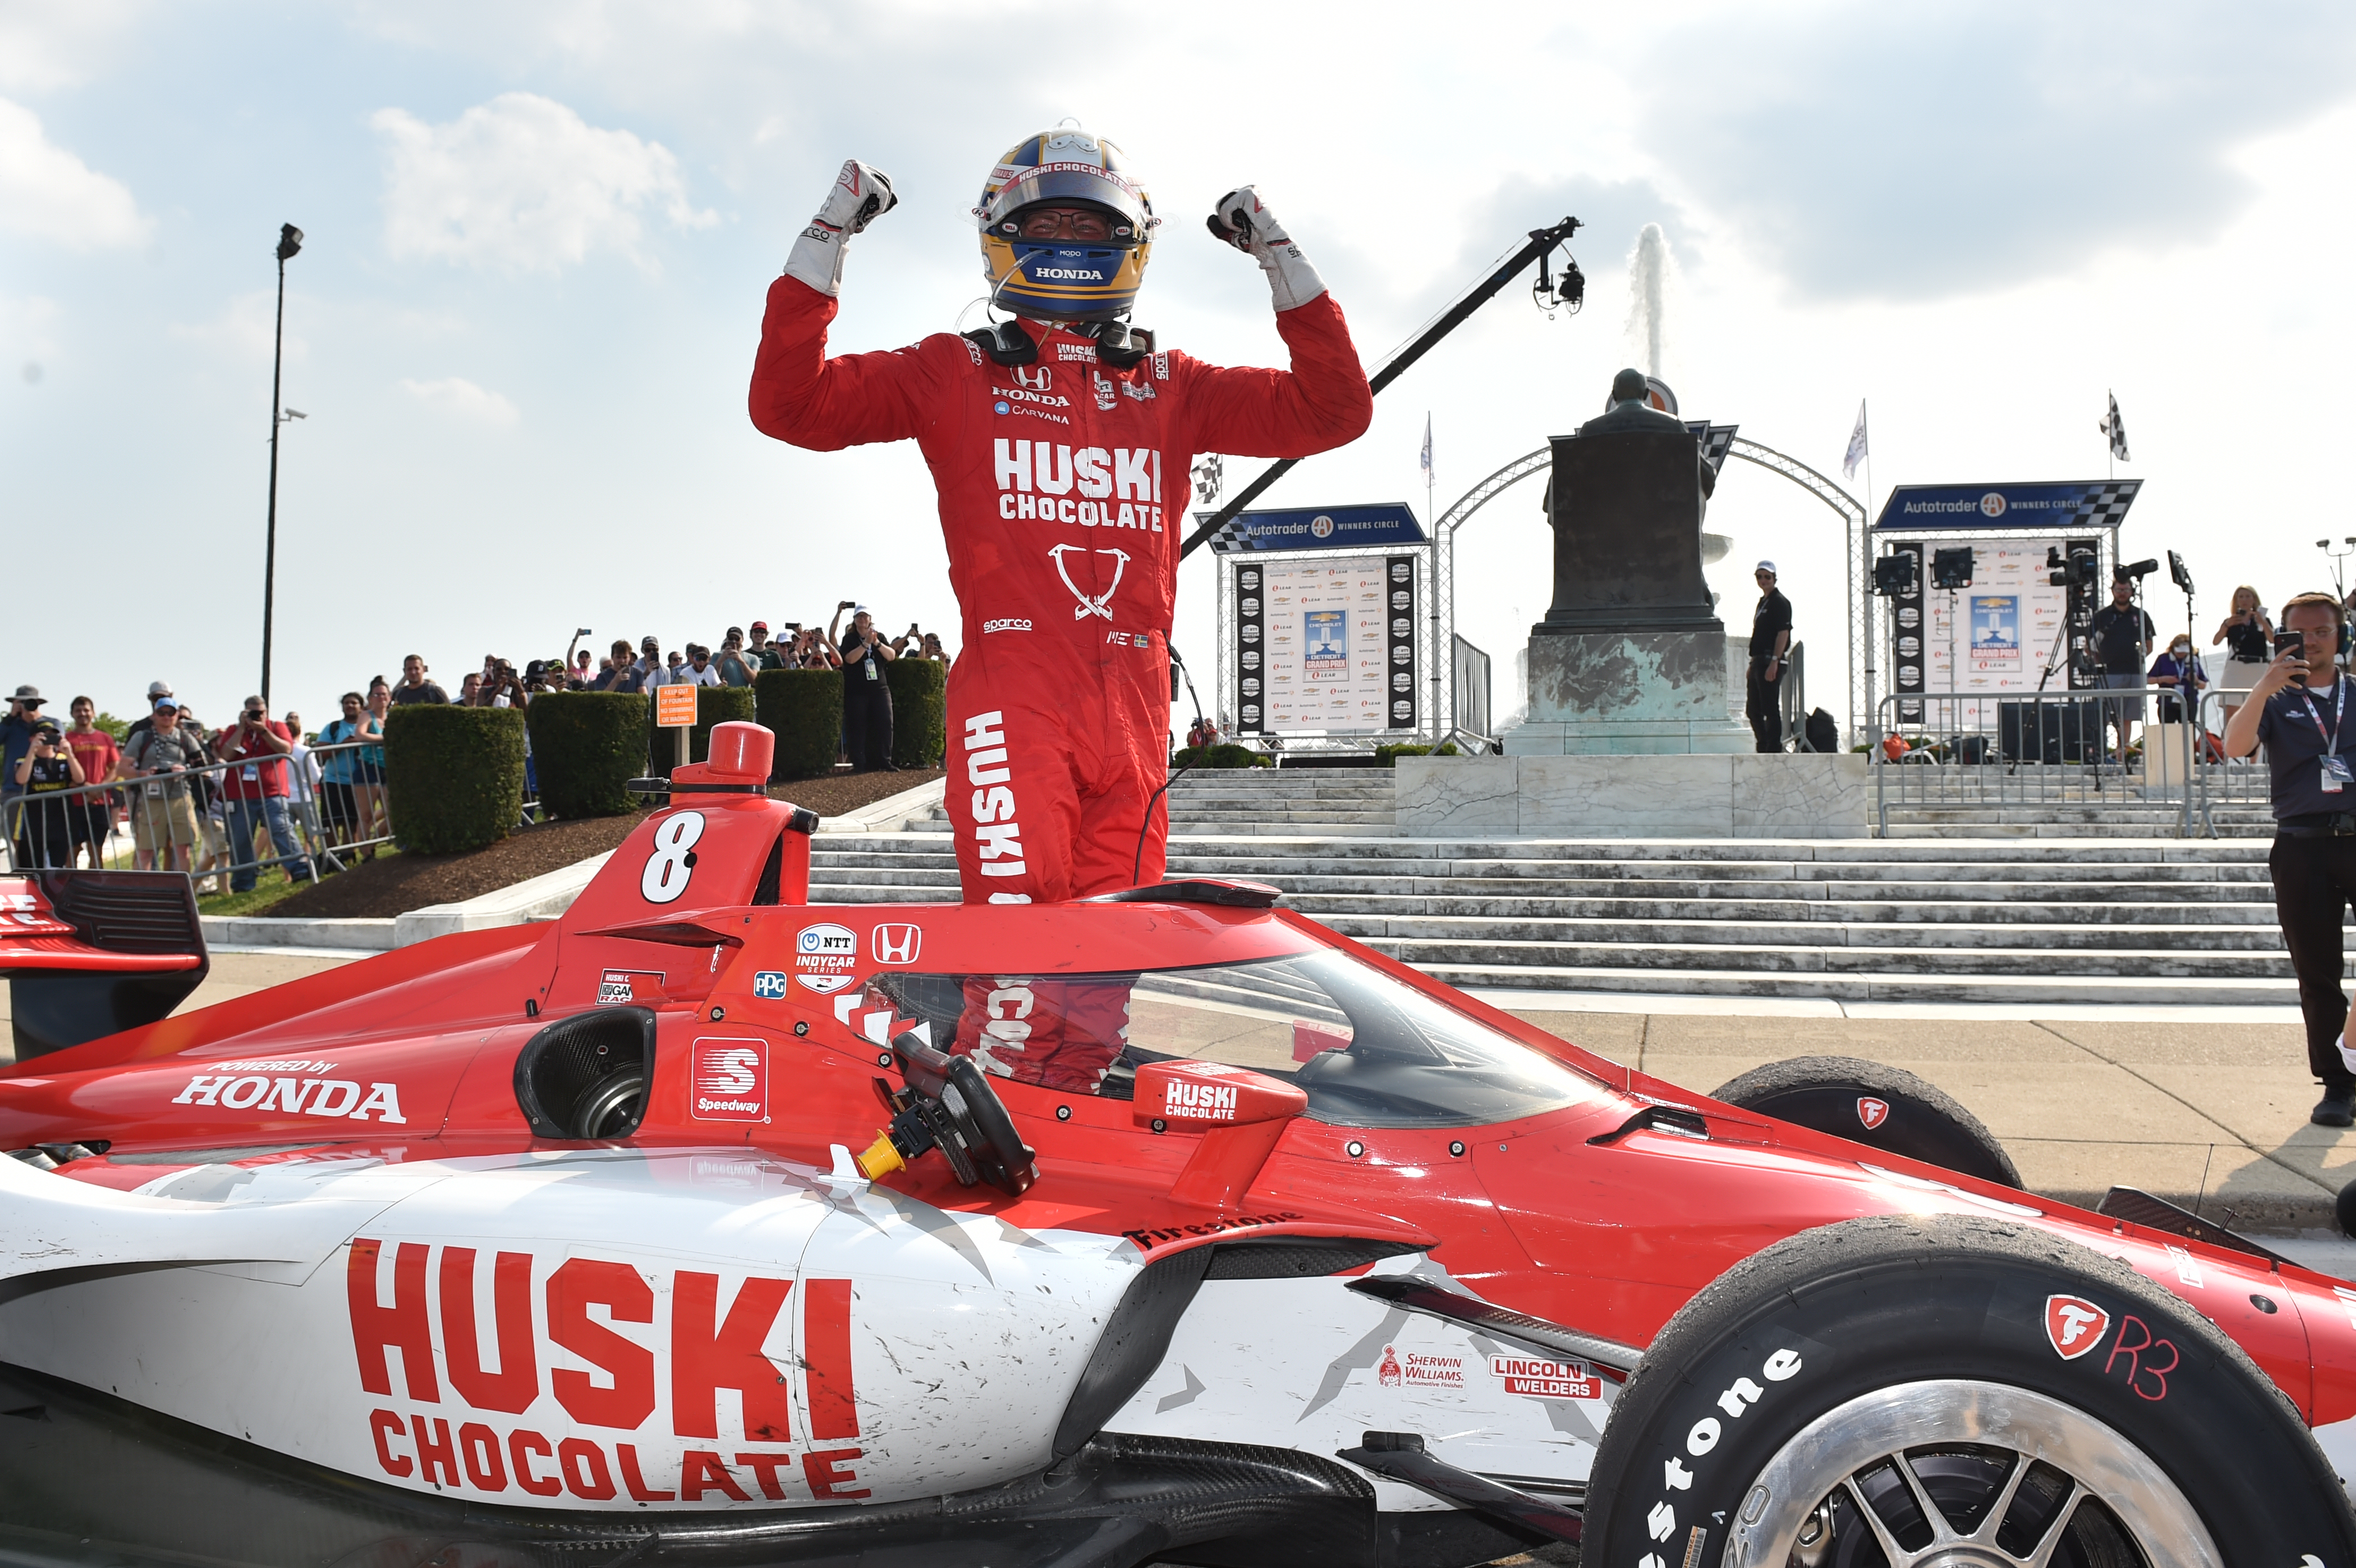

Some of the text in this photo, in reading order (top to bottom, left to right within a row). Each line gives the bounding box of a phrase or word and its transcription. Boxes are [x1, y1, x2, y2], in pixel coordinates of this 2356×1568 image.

[1020, 163, 1125, 189] HUSKI CHOCOLATE
[1036, 267, 1103, 279] HONDA
[1056, 343, 1097, 356] HUSKI
[1058, 354, 1097, 364] CHOCOLATE
[992, 386, 1070, 407] HONDA
[1012, 405, 1069, 425] CARVANA
[994, 438, 1161, 503] HUSKI
[999, 493, 1162, 532] CHOCOLATE
[1904, 500, 1978, 513] Autotrader
[2010, 500, 2050, 509] WINNERS
[2052, 499, 2082, 508] CIRCLE
[1246, 523, 1309, 536] Autotrader
[1338, 521, 1372, 531] WINNERS
[1374, 520, 1399, 529] CIRCLE
[983, 618, 1032, 632] sparco
[1972, 649, 2018, 658] GRAND PRIX
[1306, 659, 1345, 669] GRAND PRIX
[964, 710, 1026, 877] HUSKI
[641, 811, 706, 903] 8
[823, 937, 850, 947] NTT
[796, 955, 855, 967] INDYCAR
[207, 1060, 338, 1075] POWERED by
[171, 1075, 407, 1124] HONDA
[1166, 1082, 1237, 1109] HUSKI
[698, 1098, 761, 1114] Speedway
[1165, 1104, 1235, 1120] CHOCOLATE
[1122, 1211, 1304, 1251] Firestone
[347, 1237, 860, 1443] HUSKI
[1406, 1353, 1462, 1368] SHERWIN
[2104, 1315, 2179, 1401] R3
[1495, 1359, 1582, 1379] LINCOLN
[1514, 1379, 1590, 1396] WELDERS
[369, 1408, 872, 1502] CHOCOLATE
